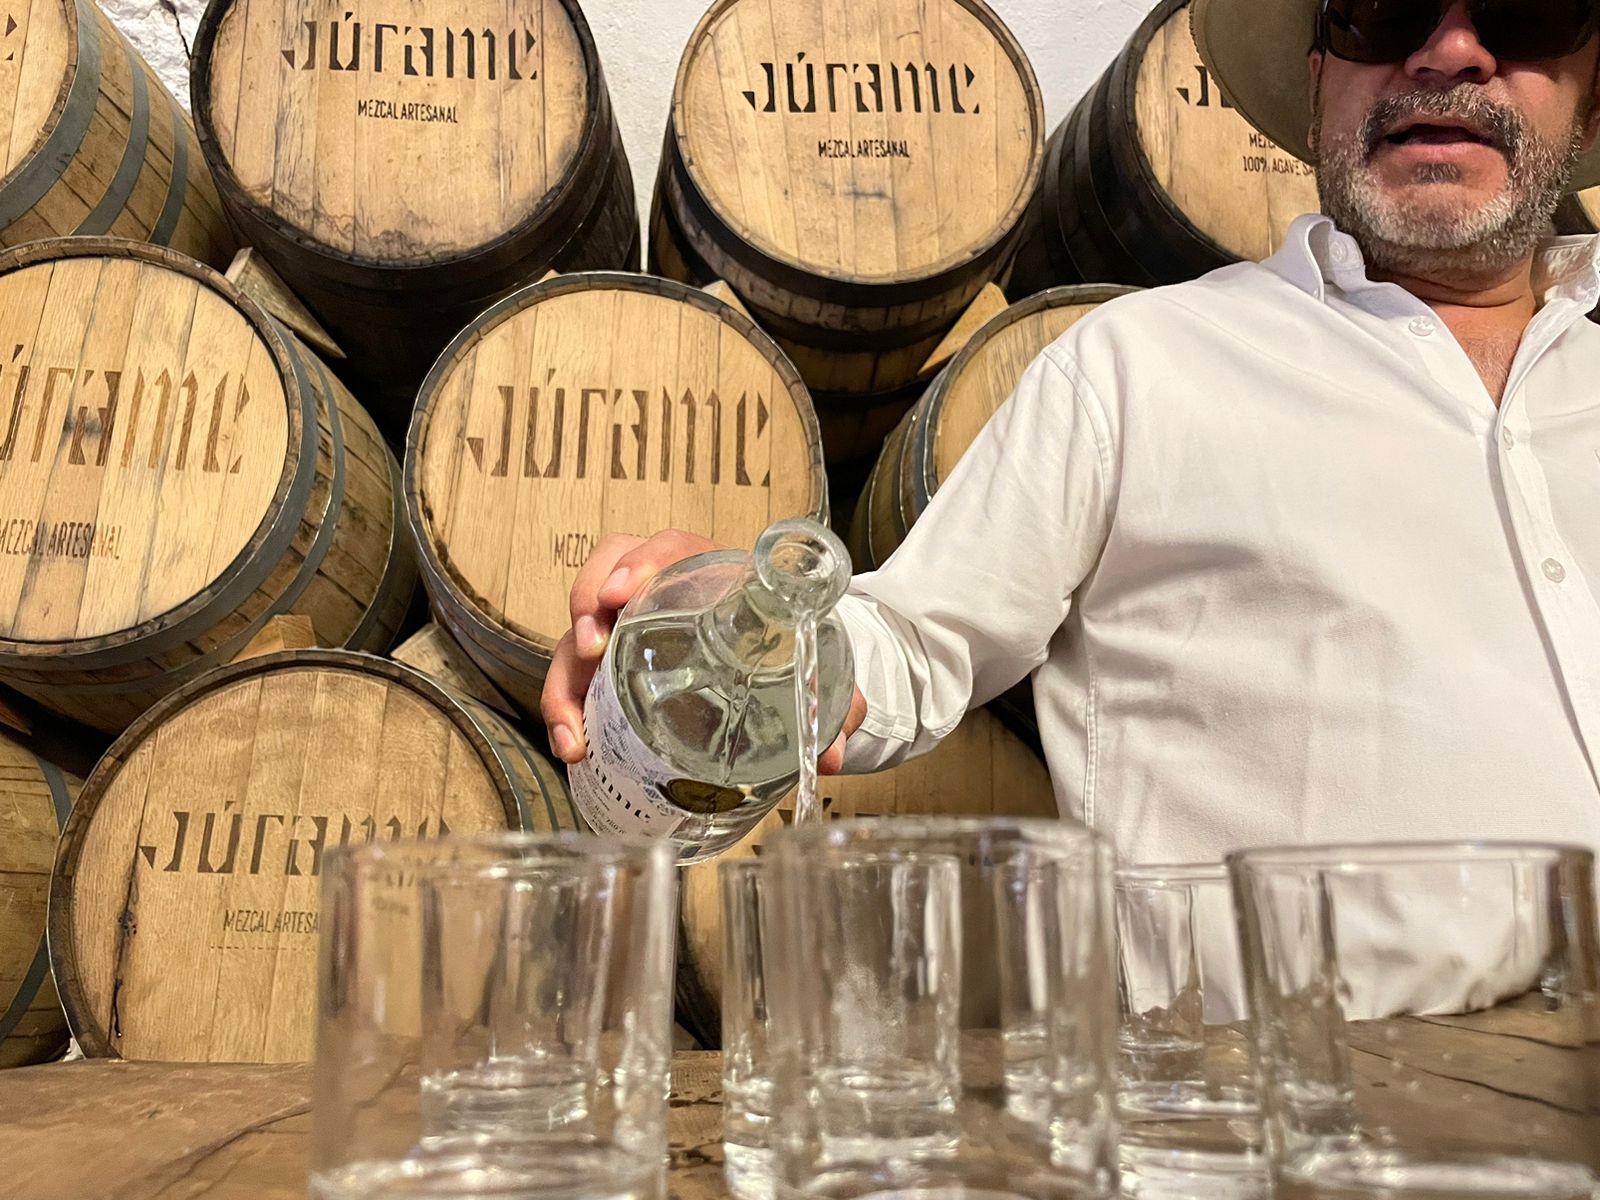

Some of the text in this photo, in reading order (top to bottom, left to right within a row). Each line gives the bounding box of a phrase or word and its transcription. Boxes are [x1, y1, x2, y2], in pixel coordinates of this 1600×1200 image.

[357, 99, 458, 124] MEZCAL ARTESANAL
[818, 139, 910, 158] MEZCAL ARTESANAL
[1272, 158, 1301, 176] AGAVE
[46, 521, 122, 560] ARTESANAL
[554, 533, 599, 568] MEZCA
[223, 909, 271, 933] MEZCAL
